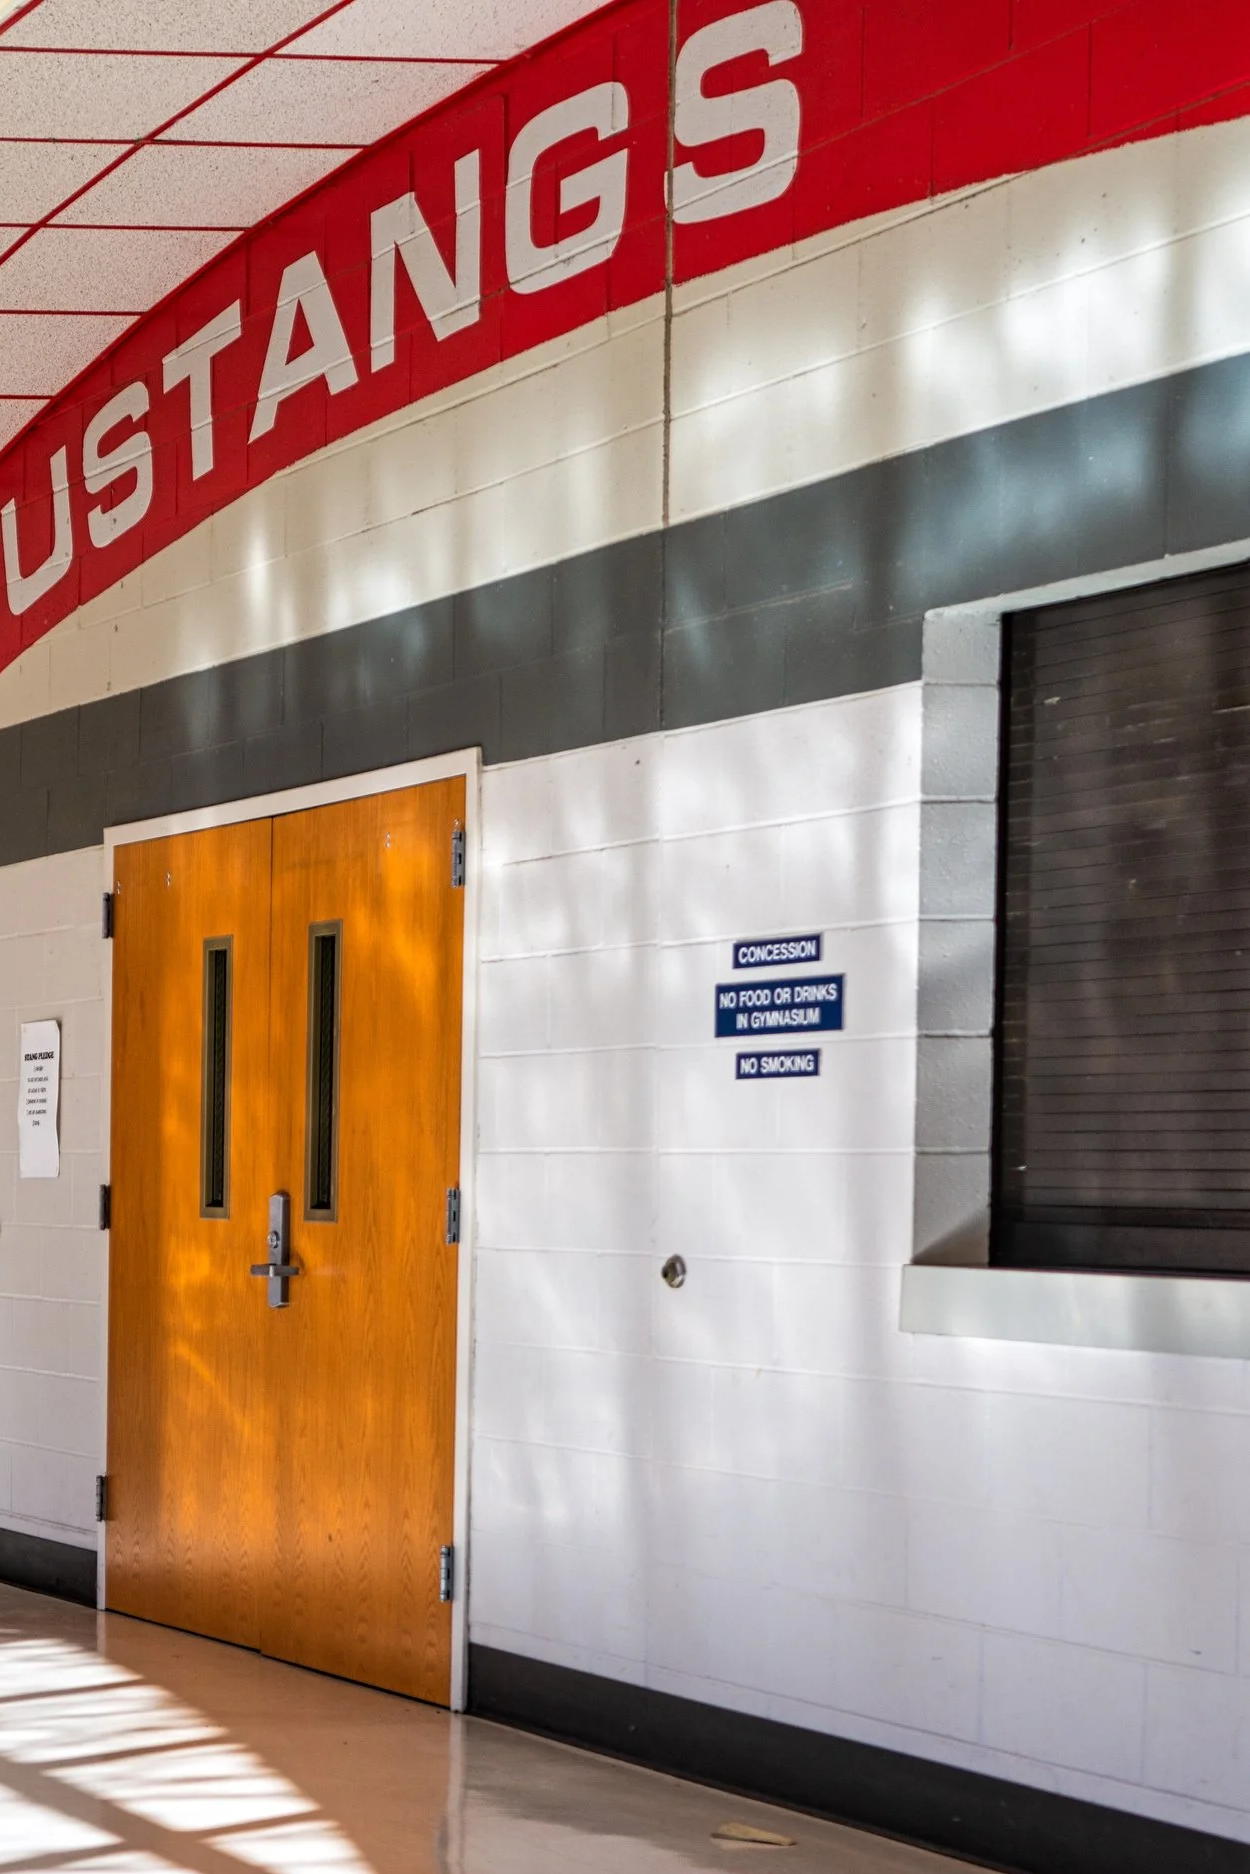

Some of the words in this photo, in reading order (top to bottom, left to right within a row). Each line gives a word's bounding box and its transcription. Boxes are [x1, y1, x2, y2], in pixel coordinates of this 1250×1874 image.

[738, 940, 816, 964] CONCESSION
[719, 991, 737, 1009] NO
[739, 989, 771, 1007] FOOD
[774, 987, 791, 1004] OR
[794, 983, 837, 1002] DRINKS
[736, 1013, 748, 1030] IN
[751, 1007, 820, 1029] GYMNASIUM
[38, 1051, 54, 1060] PLEDGE
[740, 1057, 757, 1074] NO
[760, 1055, 814, 1073] SMOKING
